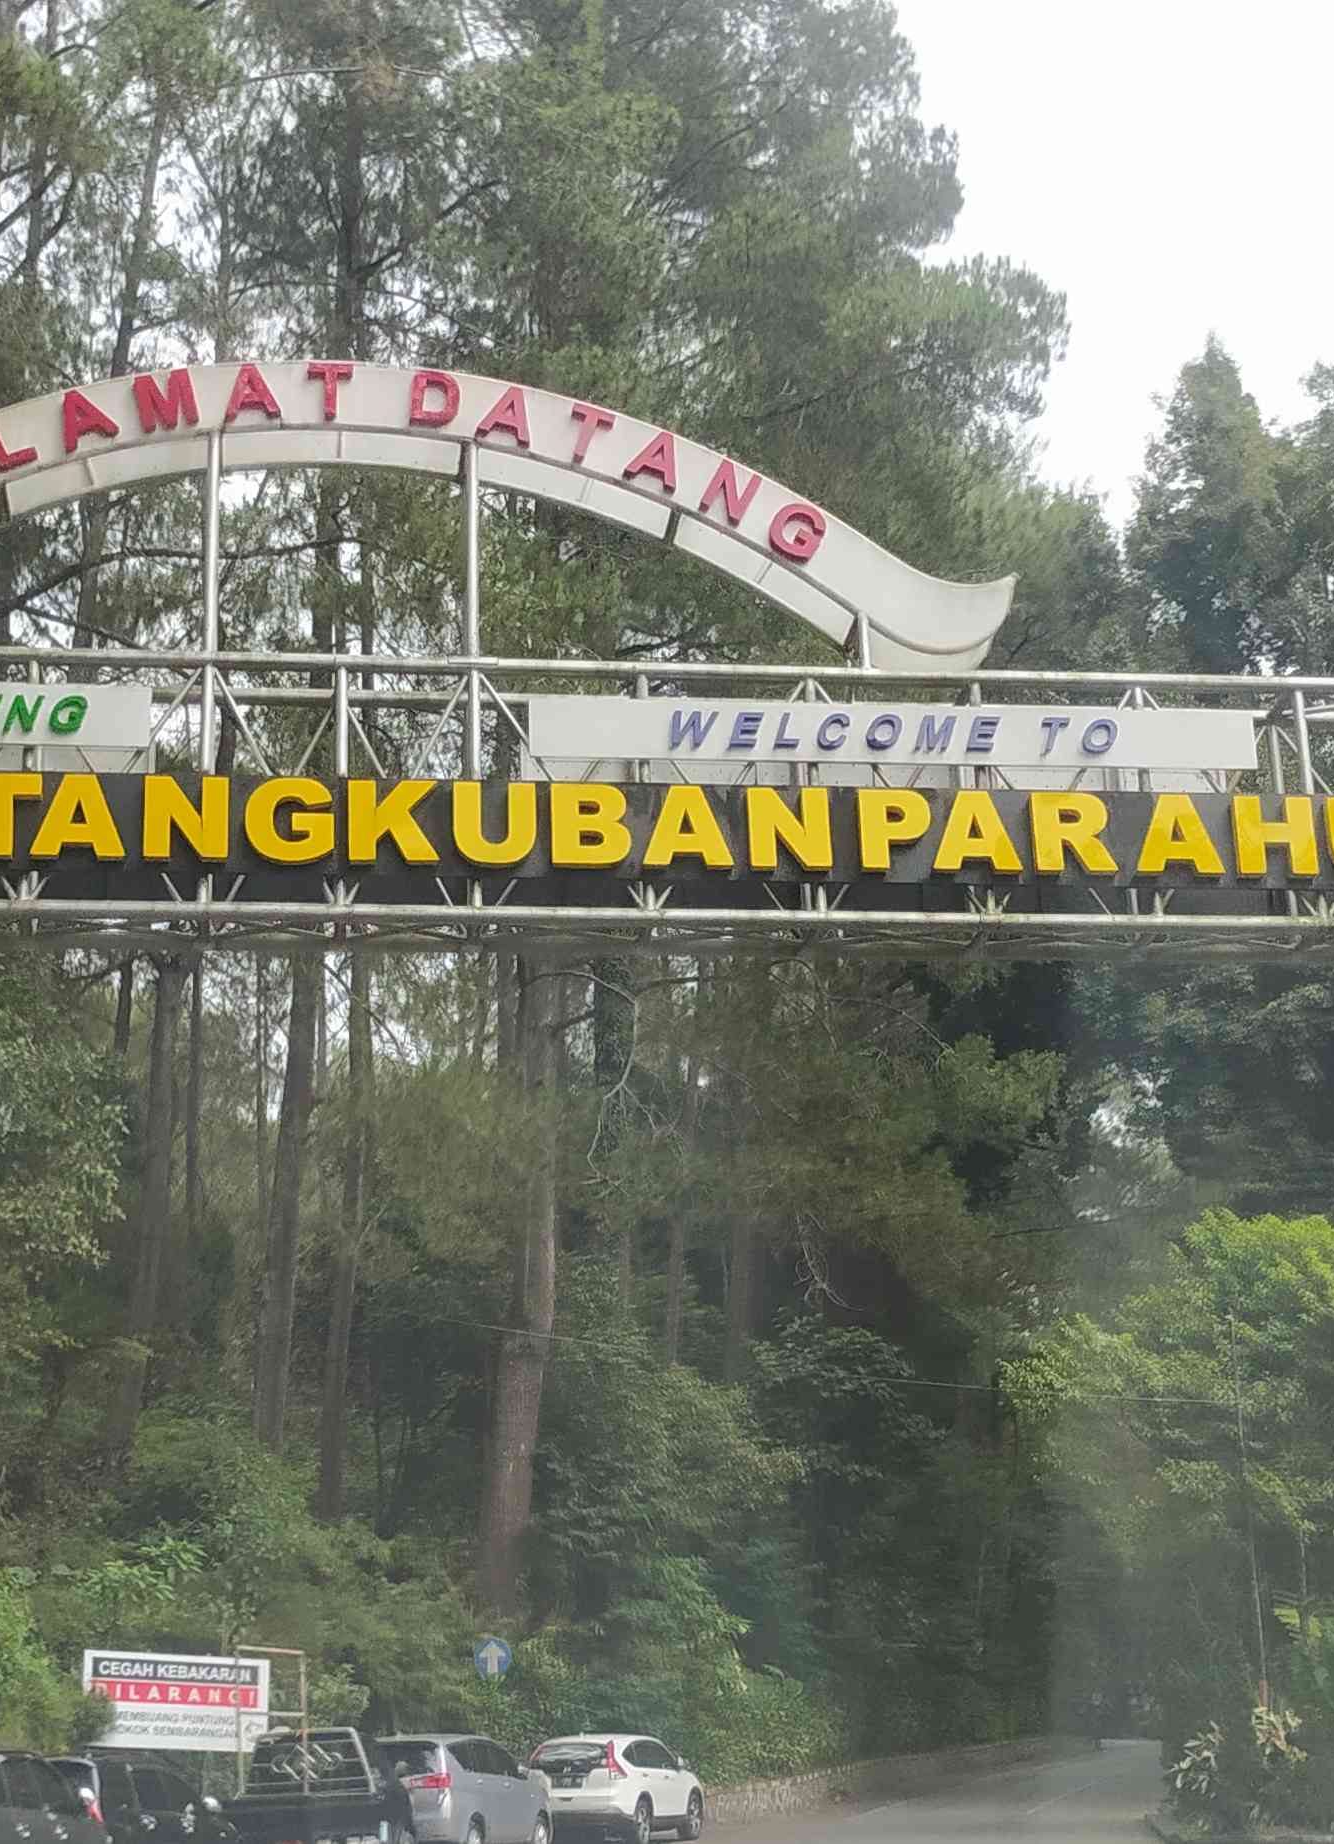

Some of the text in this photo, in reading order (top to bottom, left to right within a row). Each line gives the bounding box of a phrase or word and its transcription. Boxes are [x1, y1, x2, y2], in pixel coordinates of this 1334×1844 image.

[407, 369, 828, 564] DATANG
[667, 709, 1120, 755] WELCOME TO
[98, 1660, 252, 1682] CEGAH KEBAKARAN
